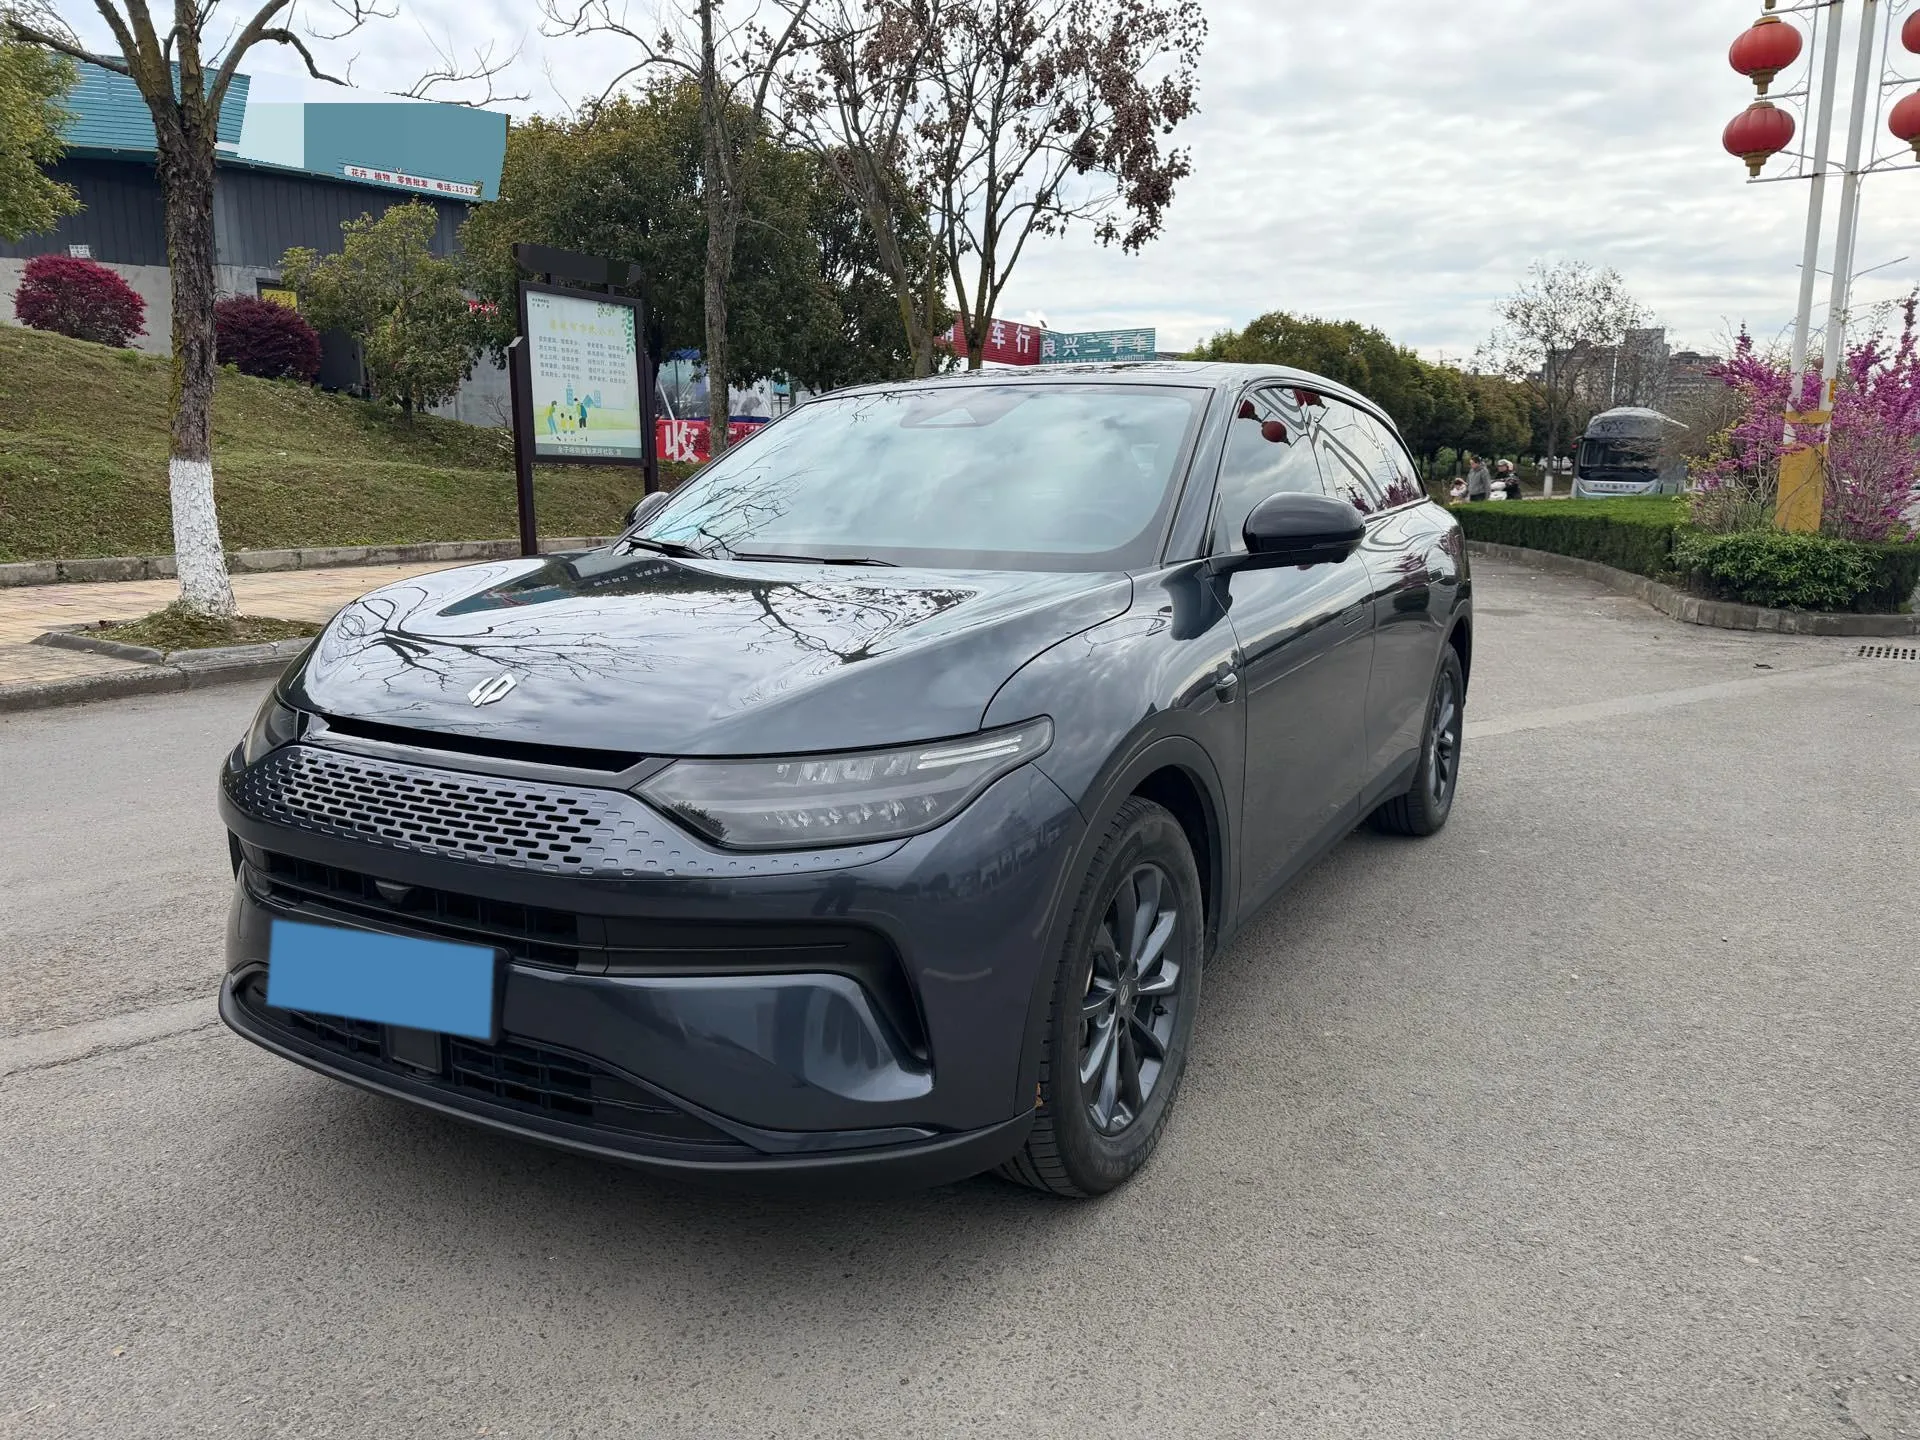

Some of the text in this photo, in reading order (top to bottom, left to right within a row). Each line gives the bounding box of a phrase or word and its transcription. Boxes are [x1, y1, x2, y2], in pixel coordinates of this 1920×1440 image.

[351, 168, 367, 178] 花卉
[374, 171, 390, 182] 植物
[397, 175, 429, 188] 零售批发
[1042, 334, 1148, 358] 良兴二手车
